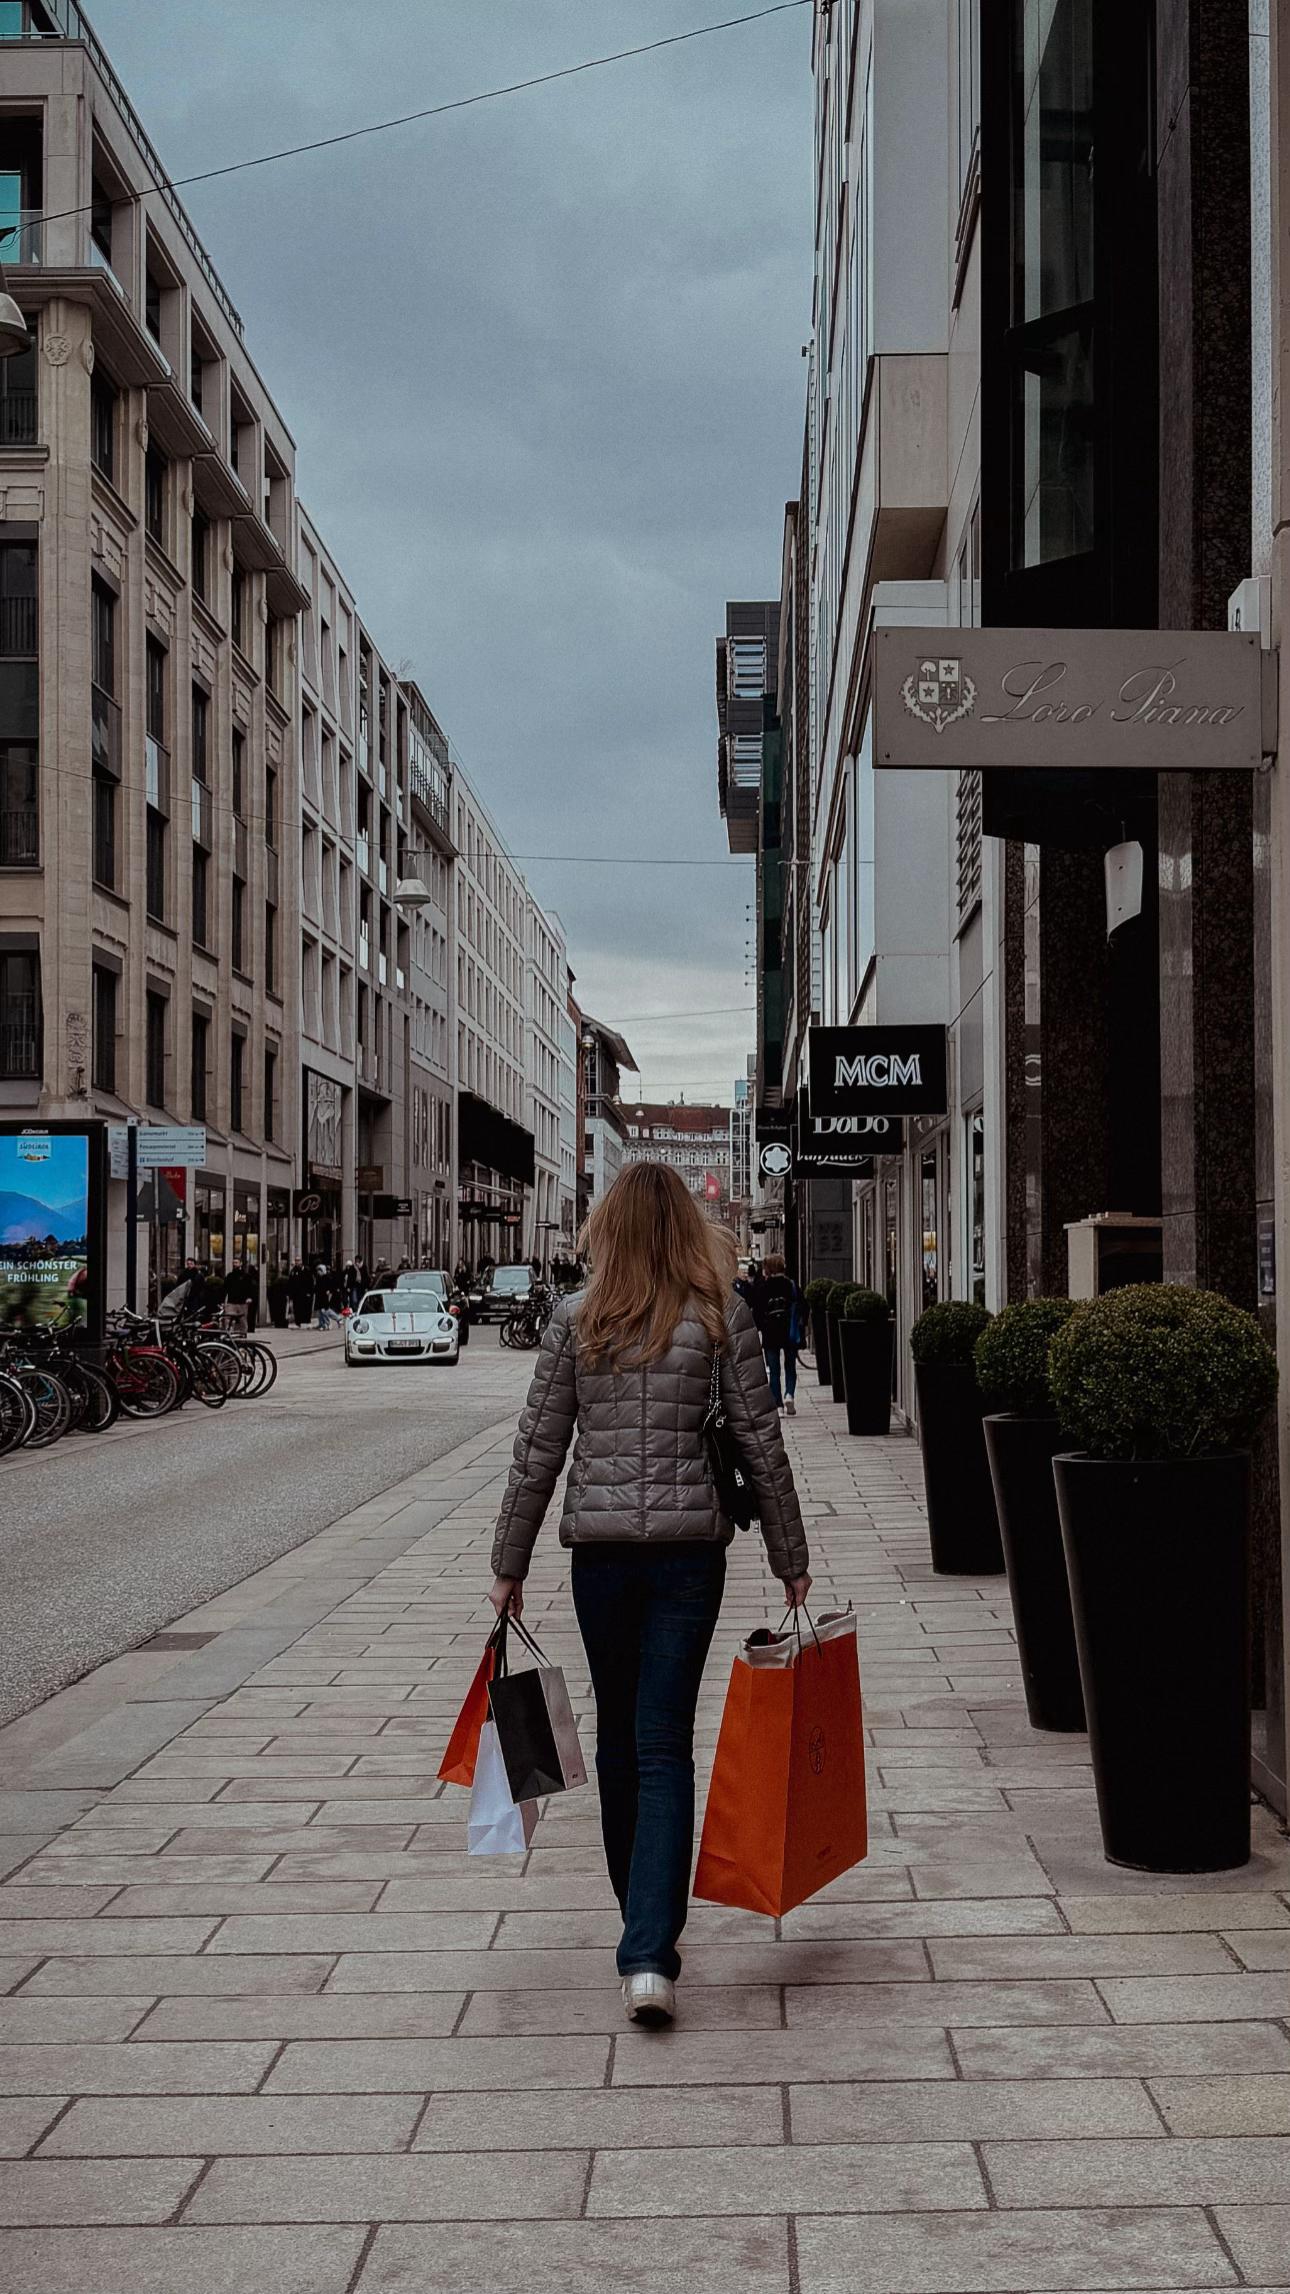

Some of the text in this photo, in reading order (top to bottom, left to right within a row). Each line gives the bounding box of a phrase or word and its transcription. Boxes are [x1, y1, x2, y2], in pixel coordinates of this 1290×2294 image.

[979, 658, 1245, 724] Loro Piana
[833, 1053, 923, 1087] MCM
[17, 1260, 77, 1270] SCHÖNSTER
[7, 1272, 59, 1283] FRÜHLING
